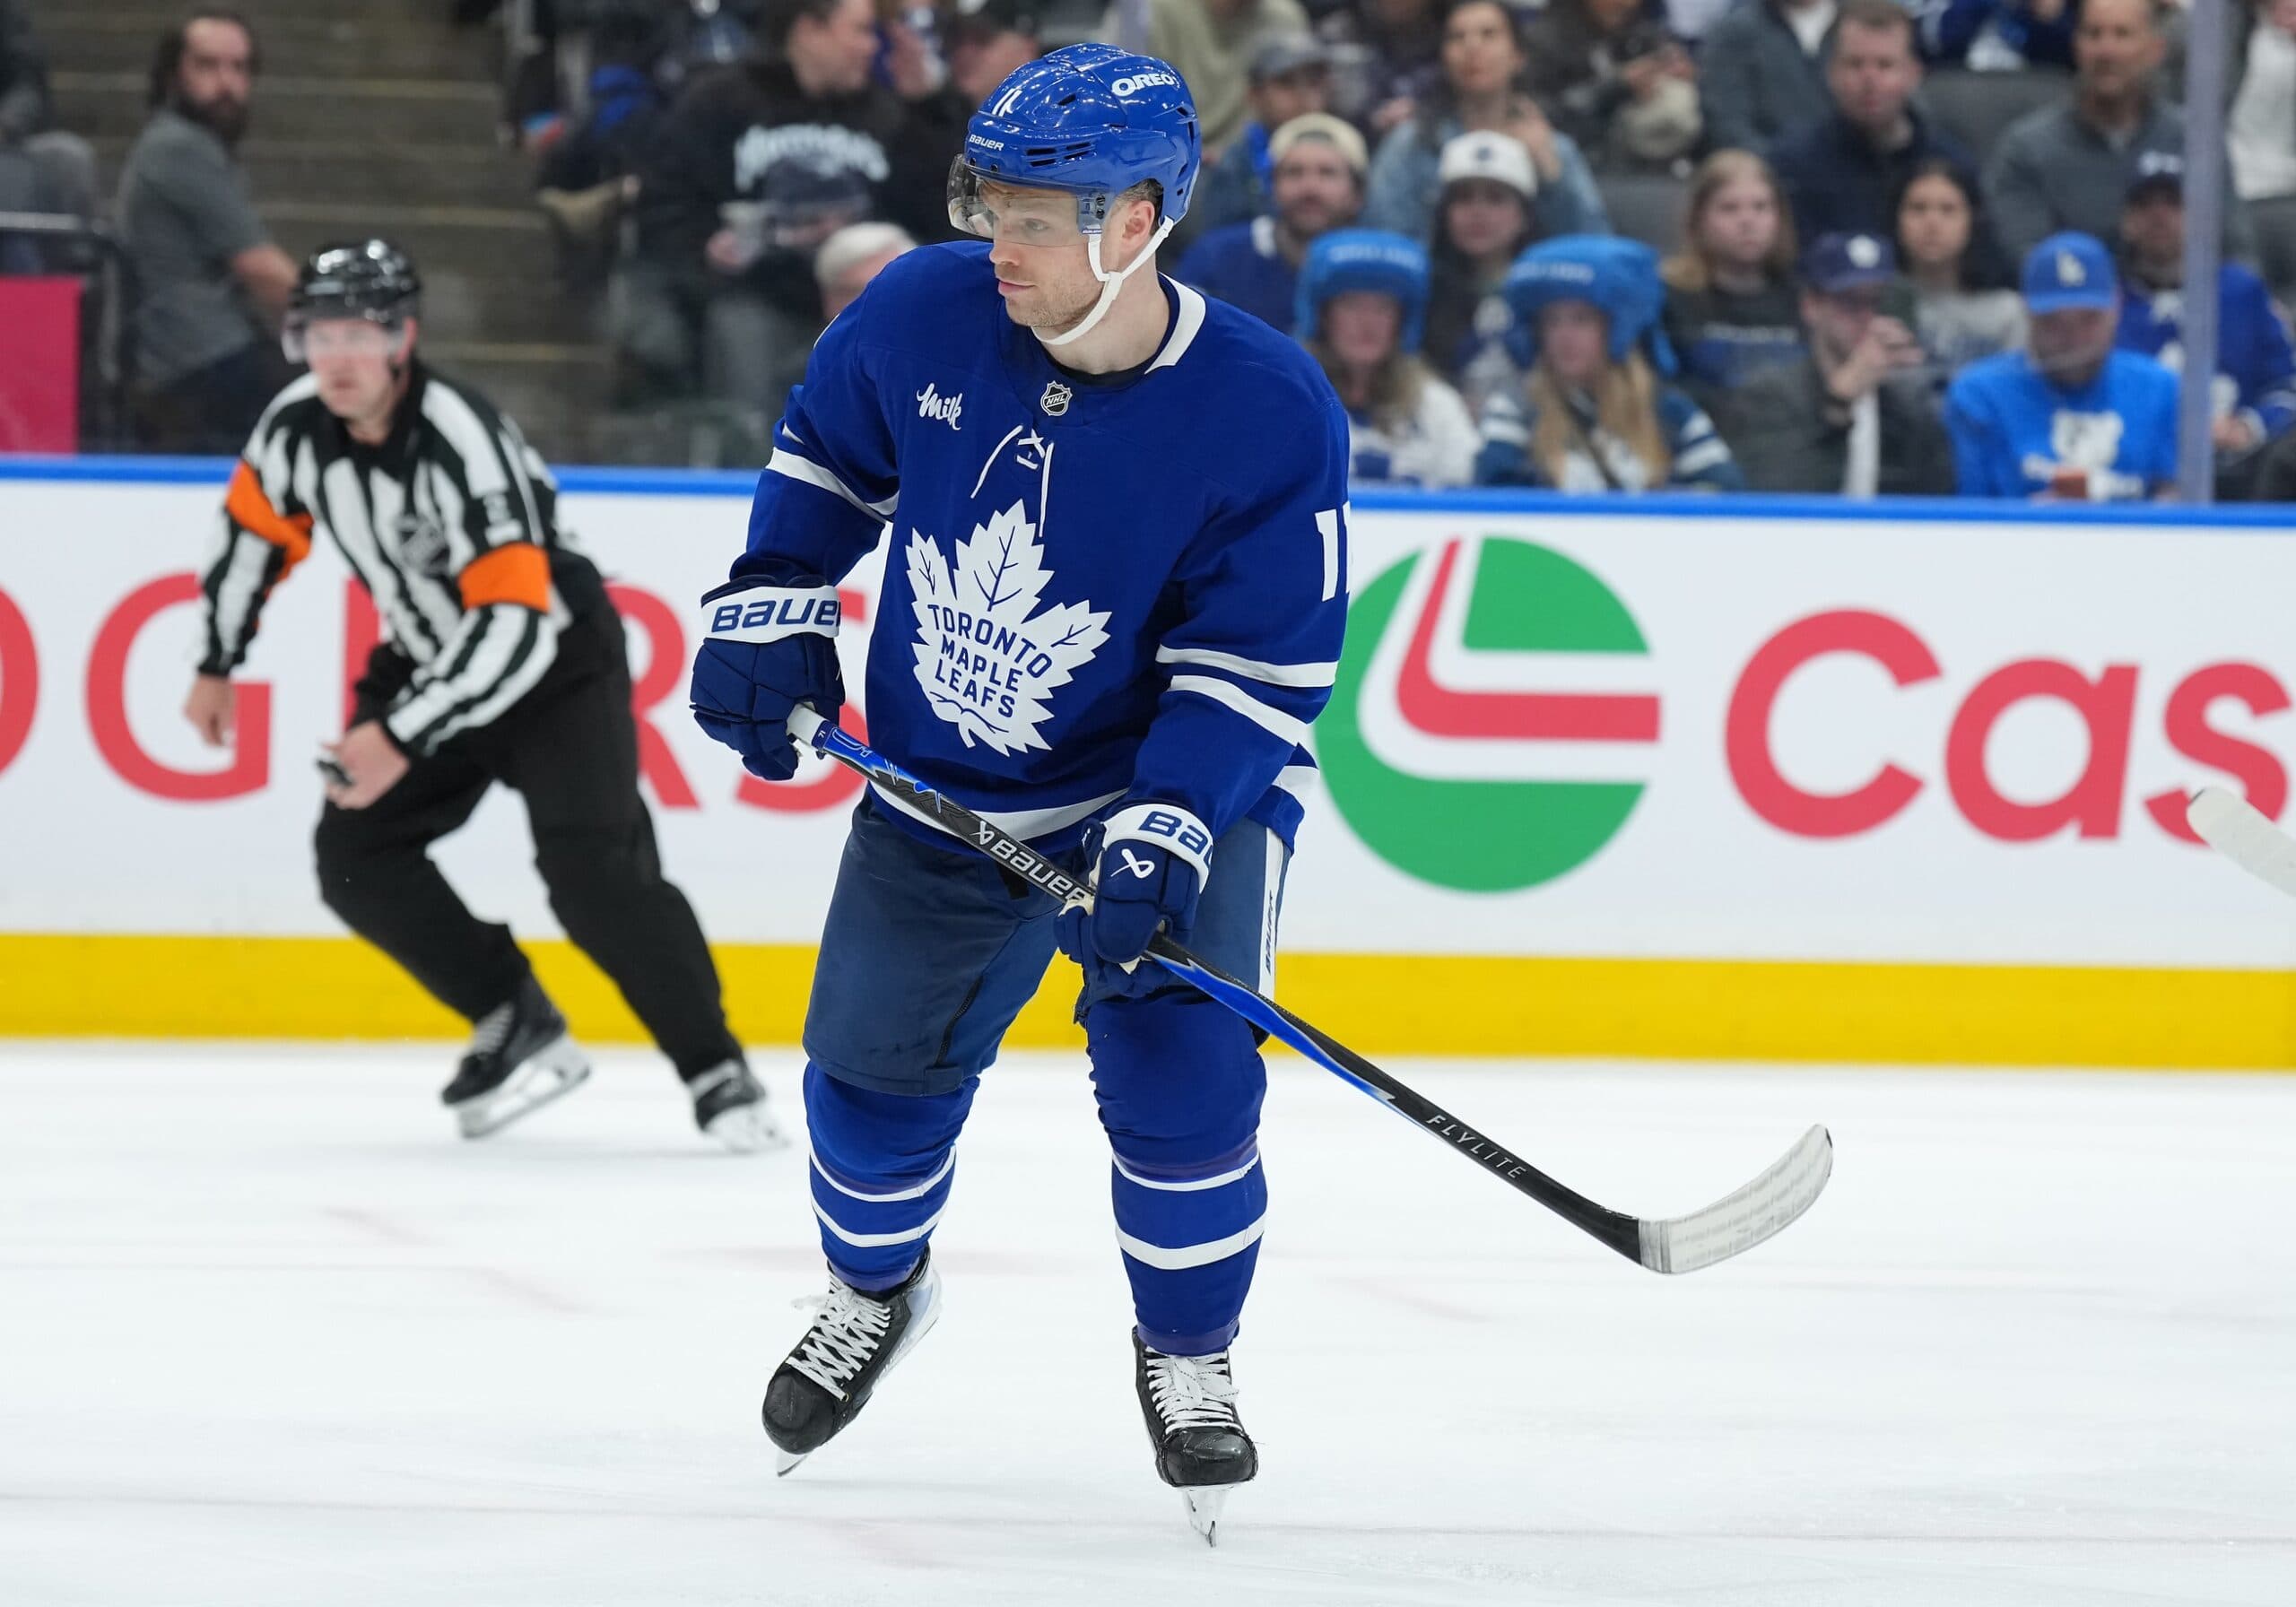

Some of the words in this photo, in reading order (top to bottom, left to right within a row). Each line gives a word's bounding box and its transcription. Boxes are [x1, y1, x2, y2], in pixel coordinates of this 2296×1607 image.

[1111, 74, 1175, 96] OREO
[917, 383, 963, 430] Milk
[1046, 395, 1066, 405] NHL
[711, 598, 841, 633] BAUE
[927, 604, 1053, 678] TORONTO
[935, 659, 1015, 718] LEAFS
[941, 634, 1023, 692] MAPLE
[1426, 1115, 1526, 1178] FLYLITE
